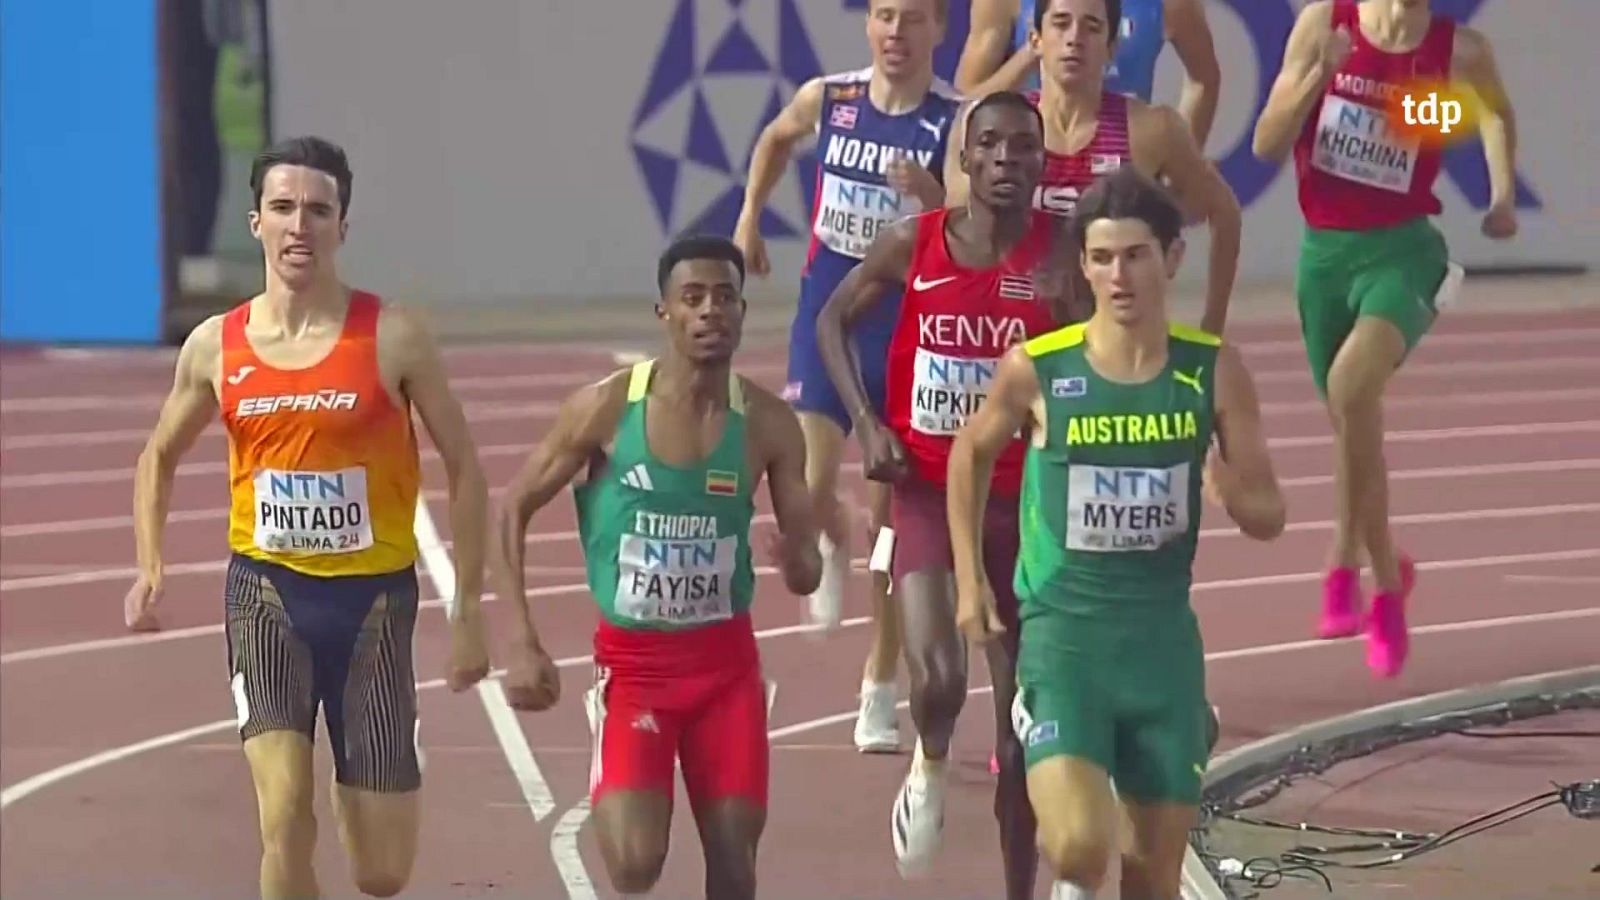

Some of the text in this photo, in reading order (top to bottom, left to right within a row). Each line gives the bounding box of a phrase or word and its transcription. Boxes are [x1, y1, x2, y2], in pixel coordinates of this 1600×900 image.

[1319, 125, 1408, 172] KHCHINA
[839, 182, 902, 212] NTN
[821, 205, 857, 236] MOE
[918, 313, 1027, 349] KENYA
[236, 389, 358, 417] ESPAÑA
[1066, 411, 1197, 446] AUSTRALIA
[270, 472, 345, 500] NTN
[1094, 470, 1172, 498] NTN
[260, 501, 361, 531] PINTADO
[634, 509, 718, 539] ETHIOPIA
[1083, 502, 1178, 531] MYERS
[290, 532, 360, 550] LIMA 24
[644, 541, 717, 568] NTN
[631, 570, 720, 601] FAYISA
